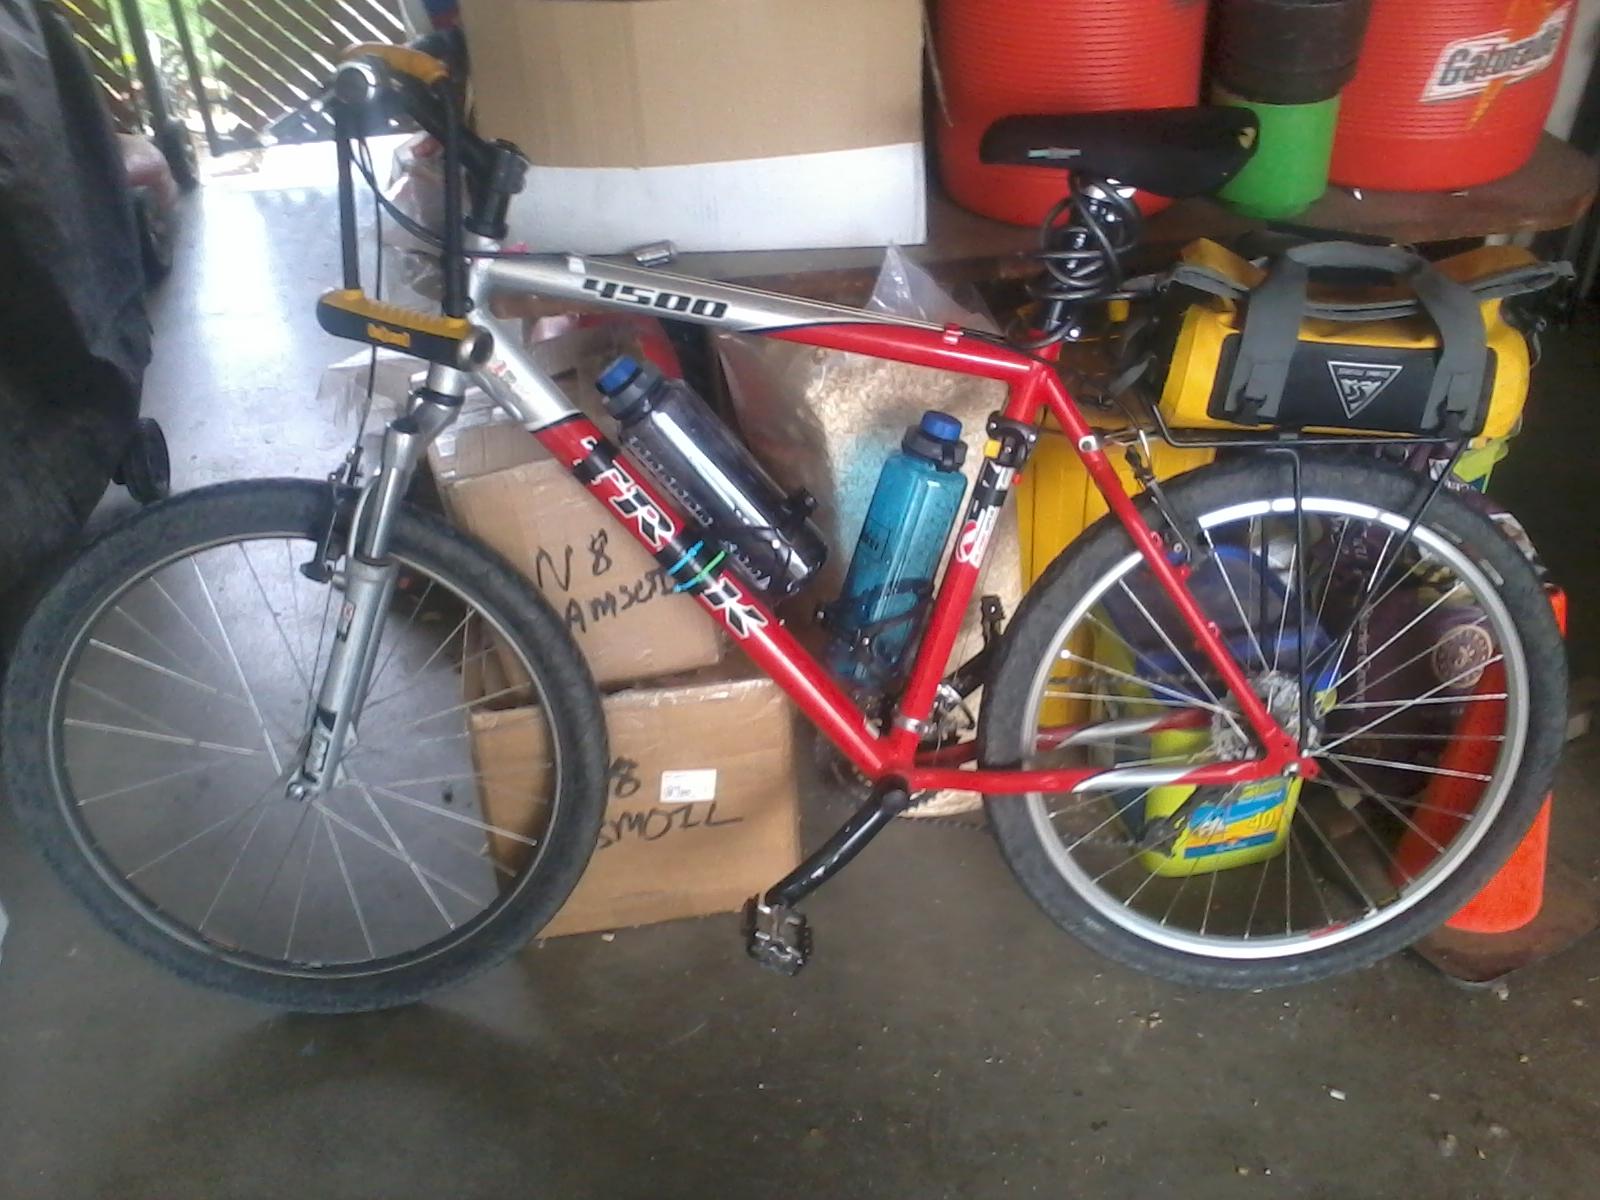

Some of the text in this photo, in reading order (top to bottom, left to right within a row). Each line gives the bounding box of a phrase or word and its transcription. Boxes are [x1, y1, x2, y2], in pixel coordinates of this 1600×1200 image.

[583, 277, 729, 319] 4500
[535, 528, 613, 592] N 8
[574, 436, 769, 639] TRK
